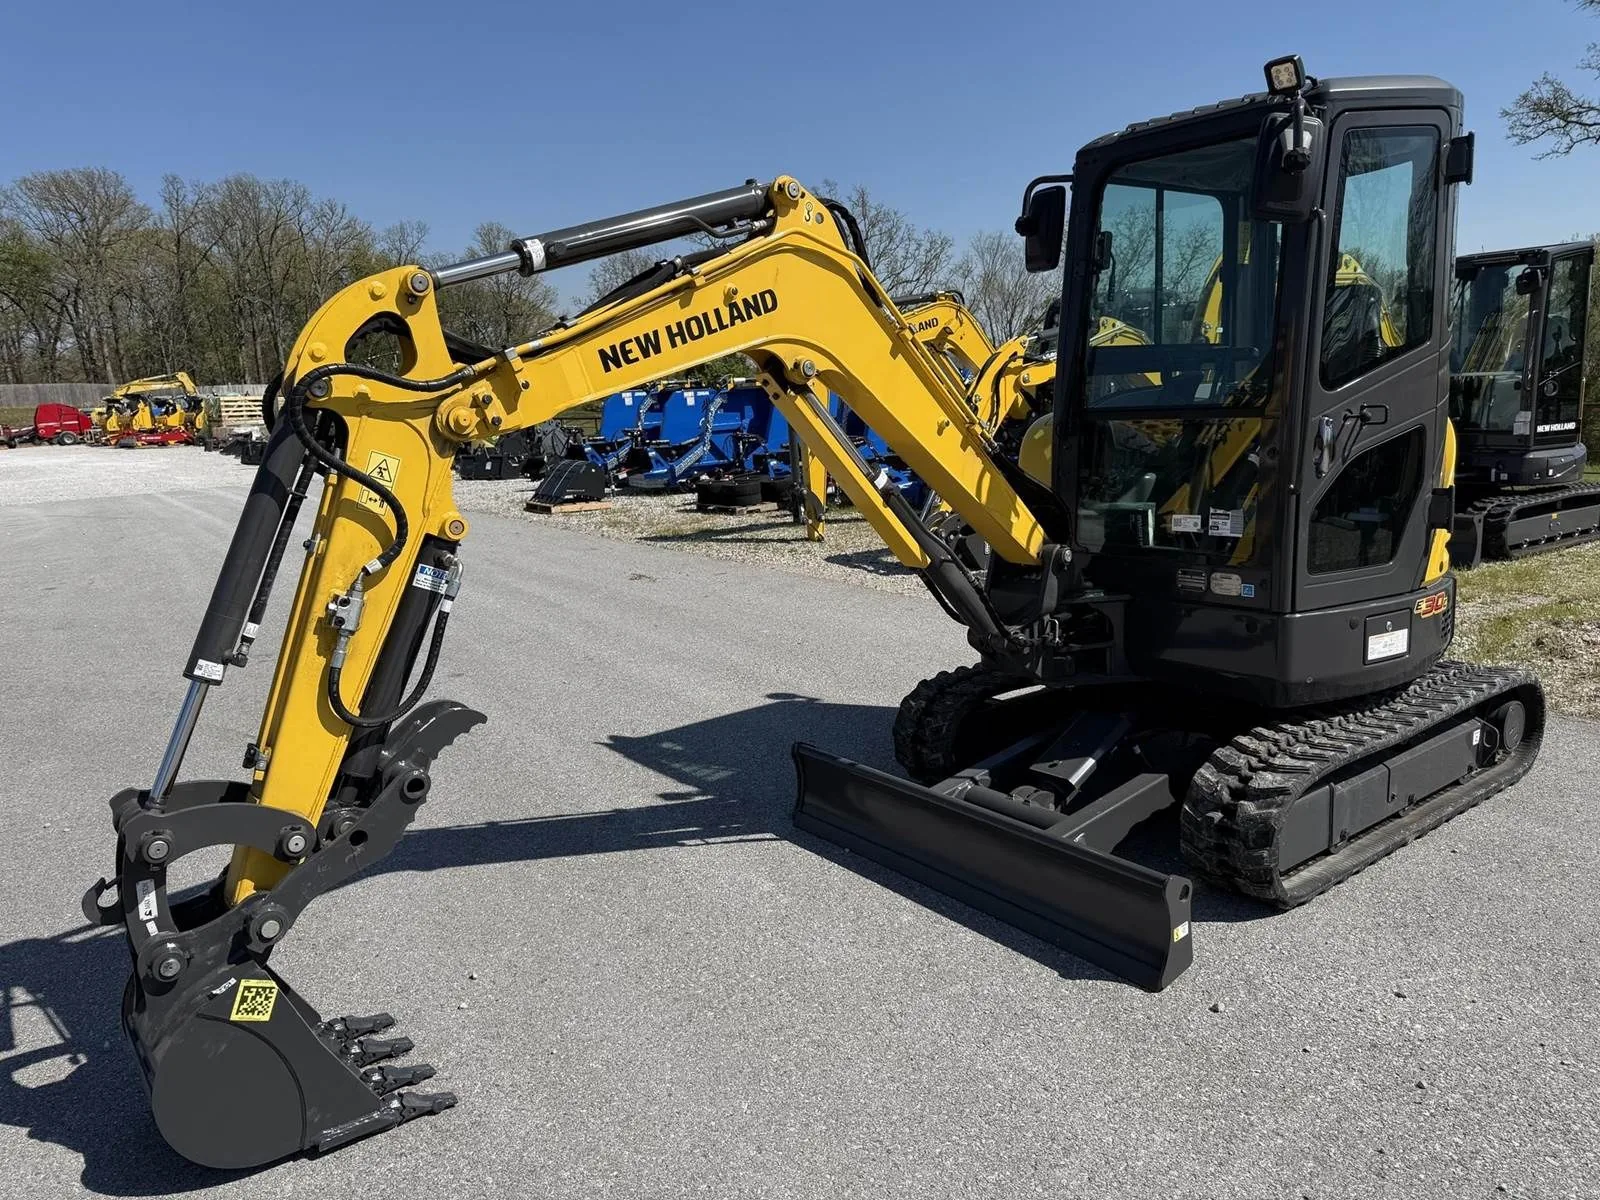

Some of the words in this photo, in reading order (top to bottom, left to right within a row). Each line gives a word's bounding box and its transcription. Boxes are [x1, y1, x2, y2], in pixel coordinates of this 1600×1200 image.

[597, 329, 662, 373] NEW
[665, 288, 778, 349] HOLLAND
[1536, 424, 1550, 433] NEW
[1551, 421, 1576, 431] HOLLAND
